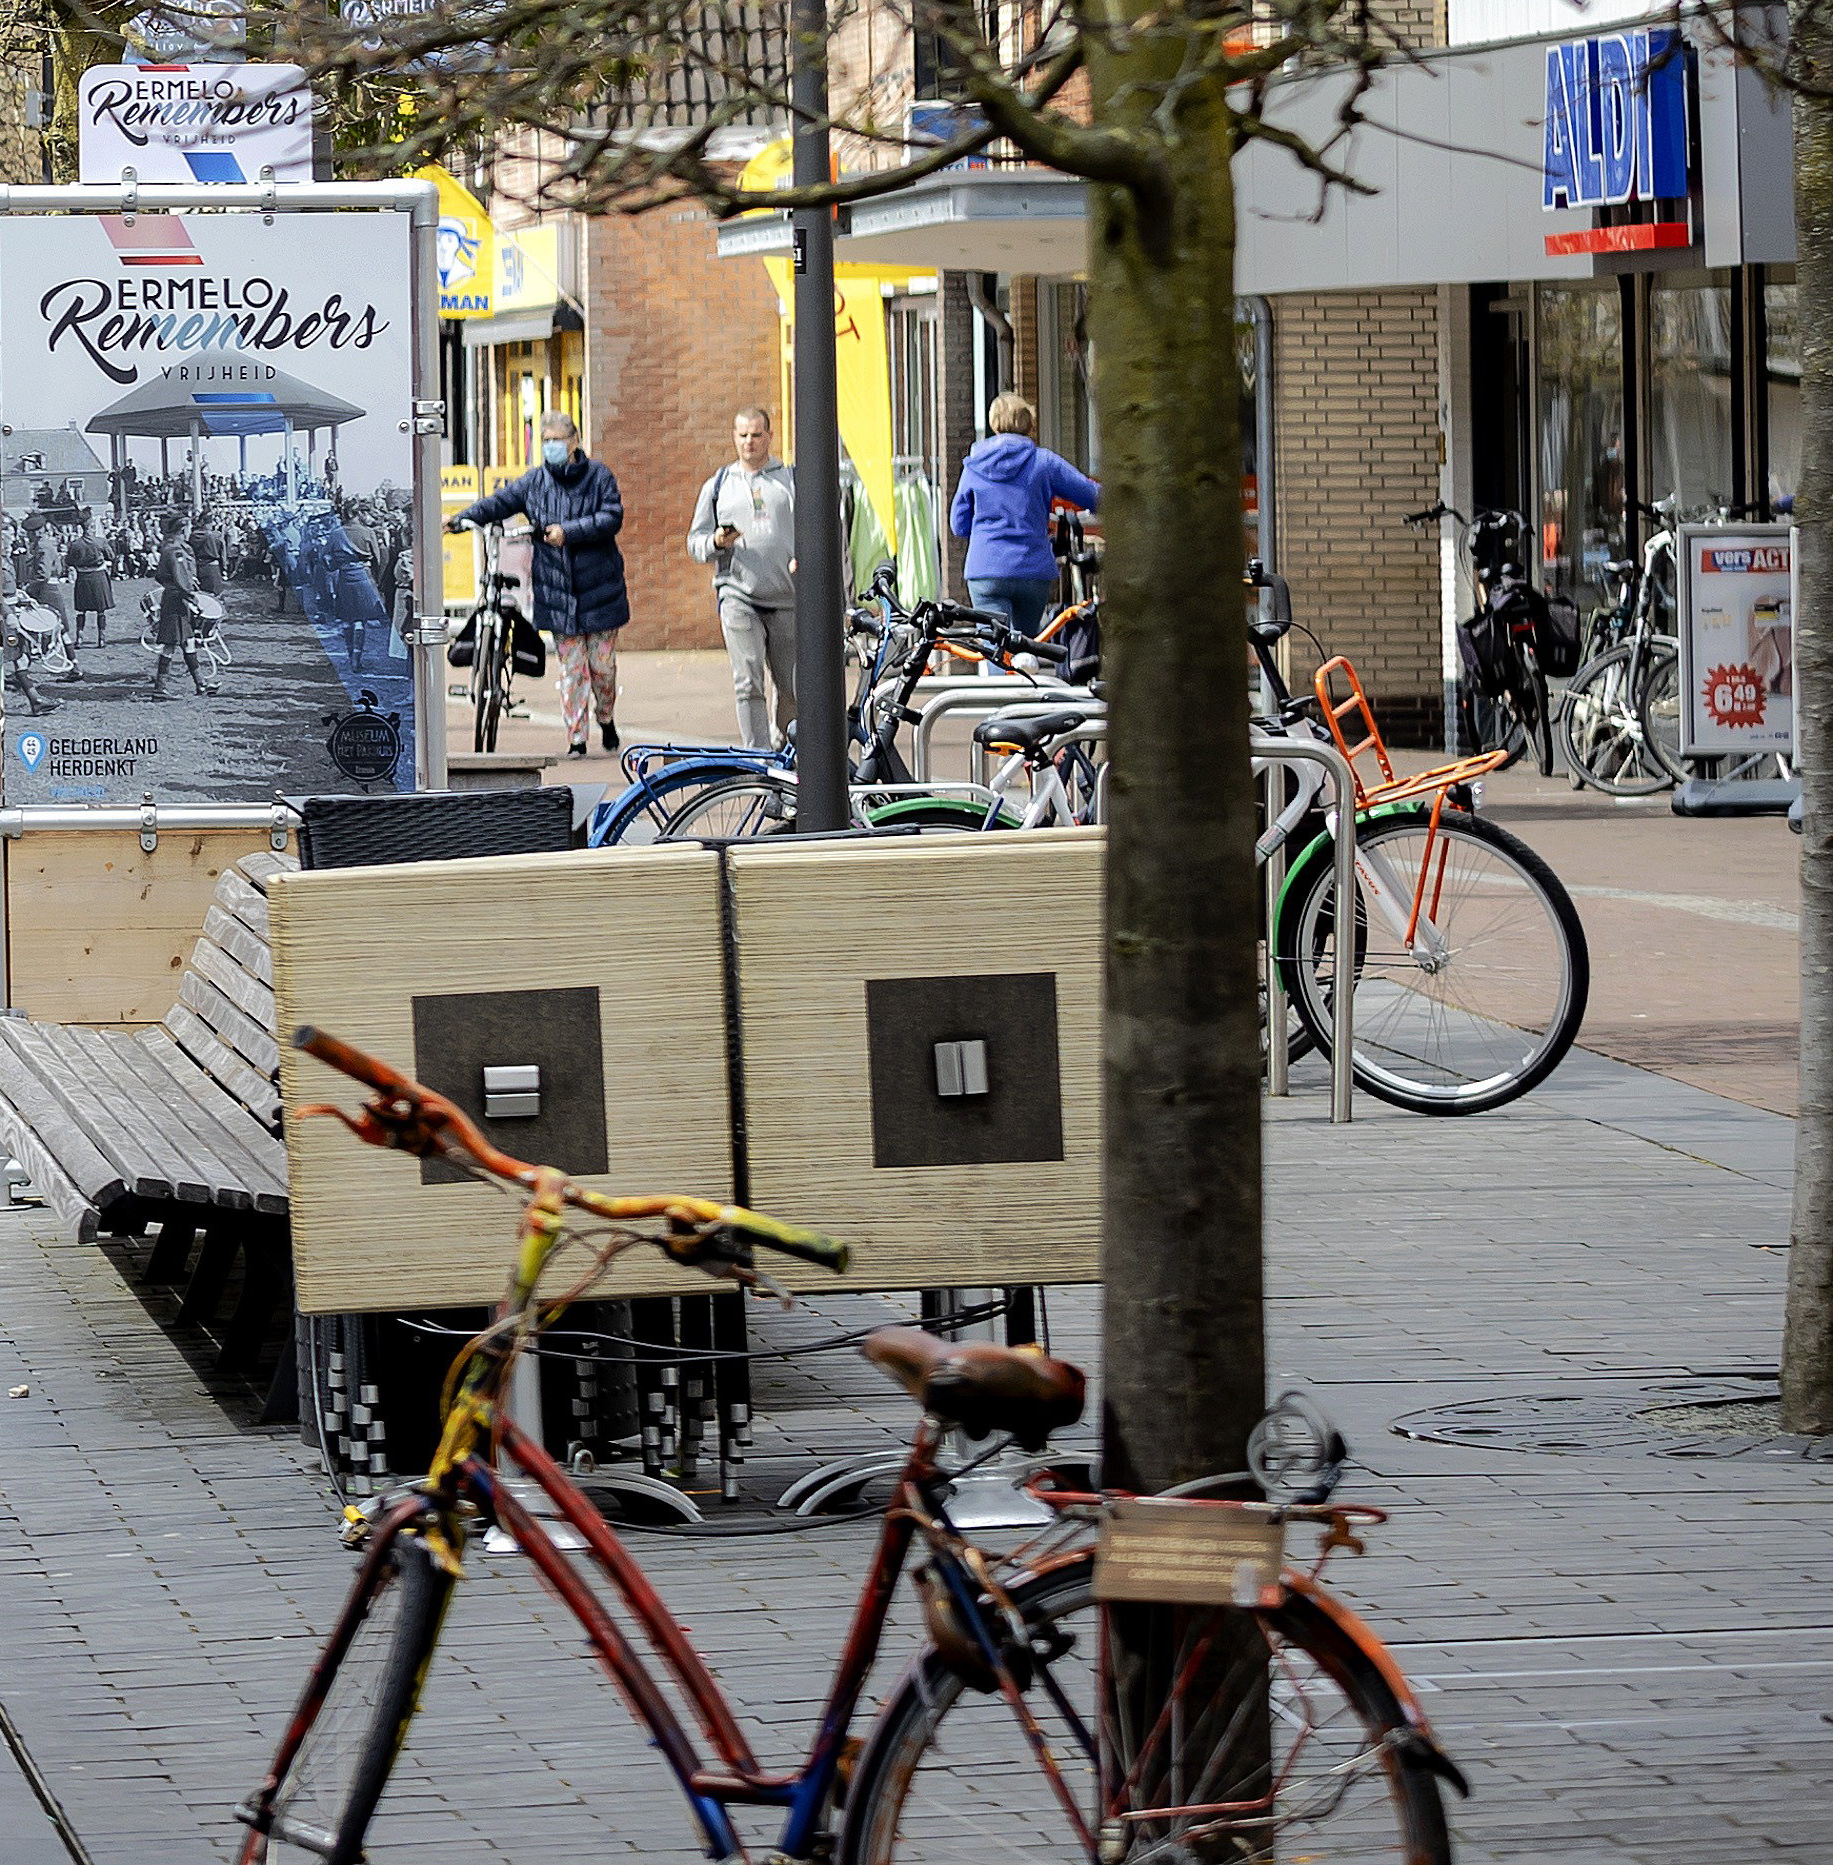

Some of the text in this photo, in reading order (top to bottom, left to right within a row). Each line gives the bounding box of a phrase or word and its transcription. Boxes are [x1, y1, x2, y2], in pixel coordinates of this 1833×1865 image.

[136, 80, 234, 100] ERMELO
[1542, 29, 1654, 212] ALDI
[118, 278, 274, 310] ERMELO
[441, 295, 489, 310] MAN
[41, 278, 390, 386] Remembers
[162, 366, 277, 381] VRIJHEID
[1753, 548, 1790, 569] ACT
[49, 738, 158, 756] GELDERLAND
[50, 759, 137, 777] HERDENKT
